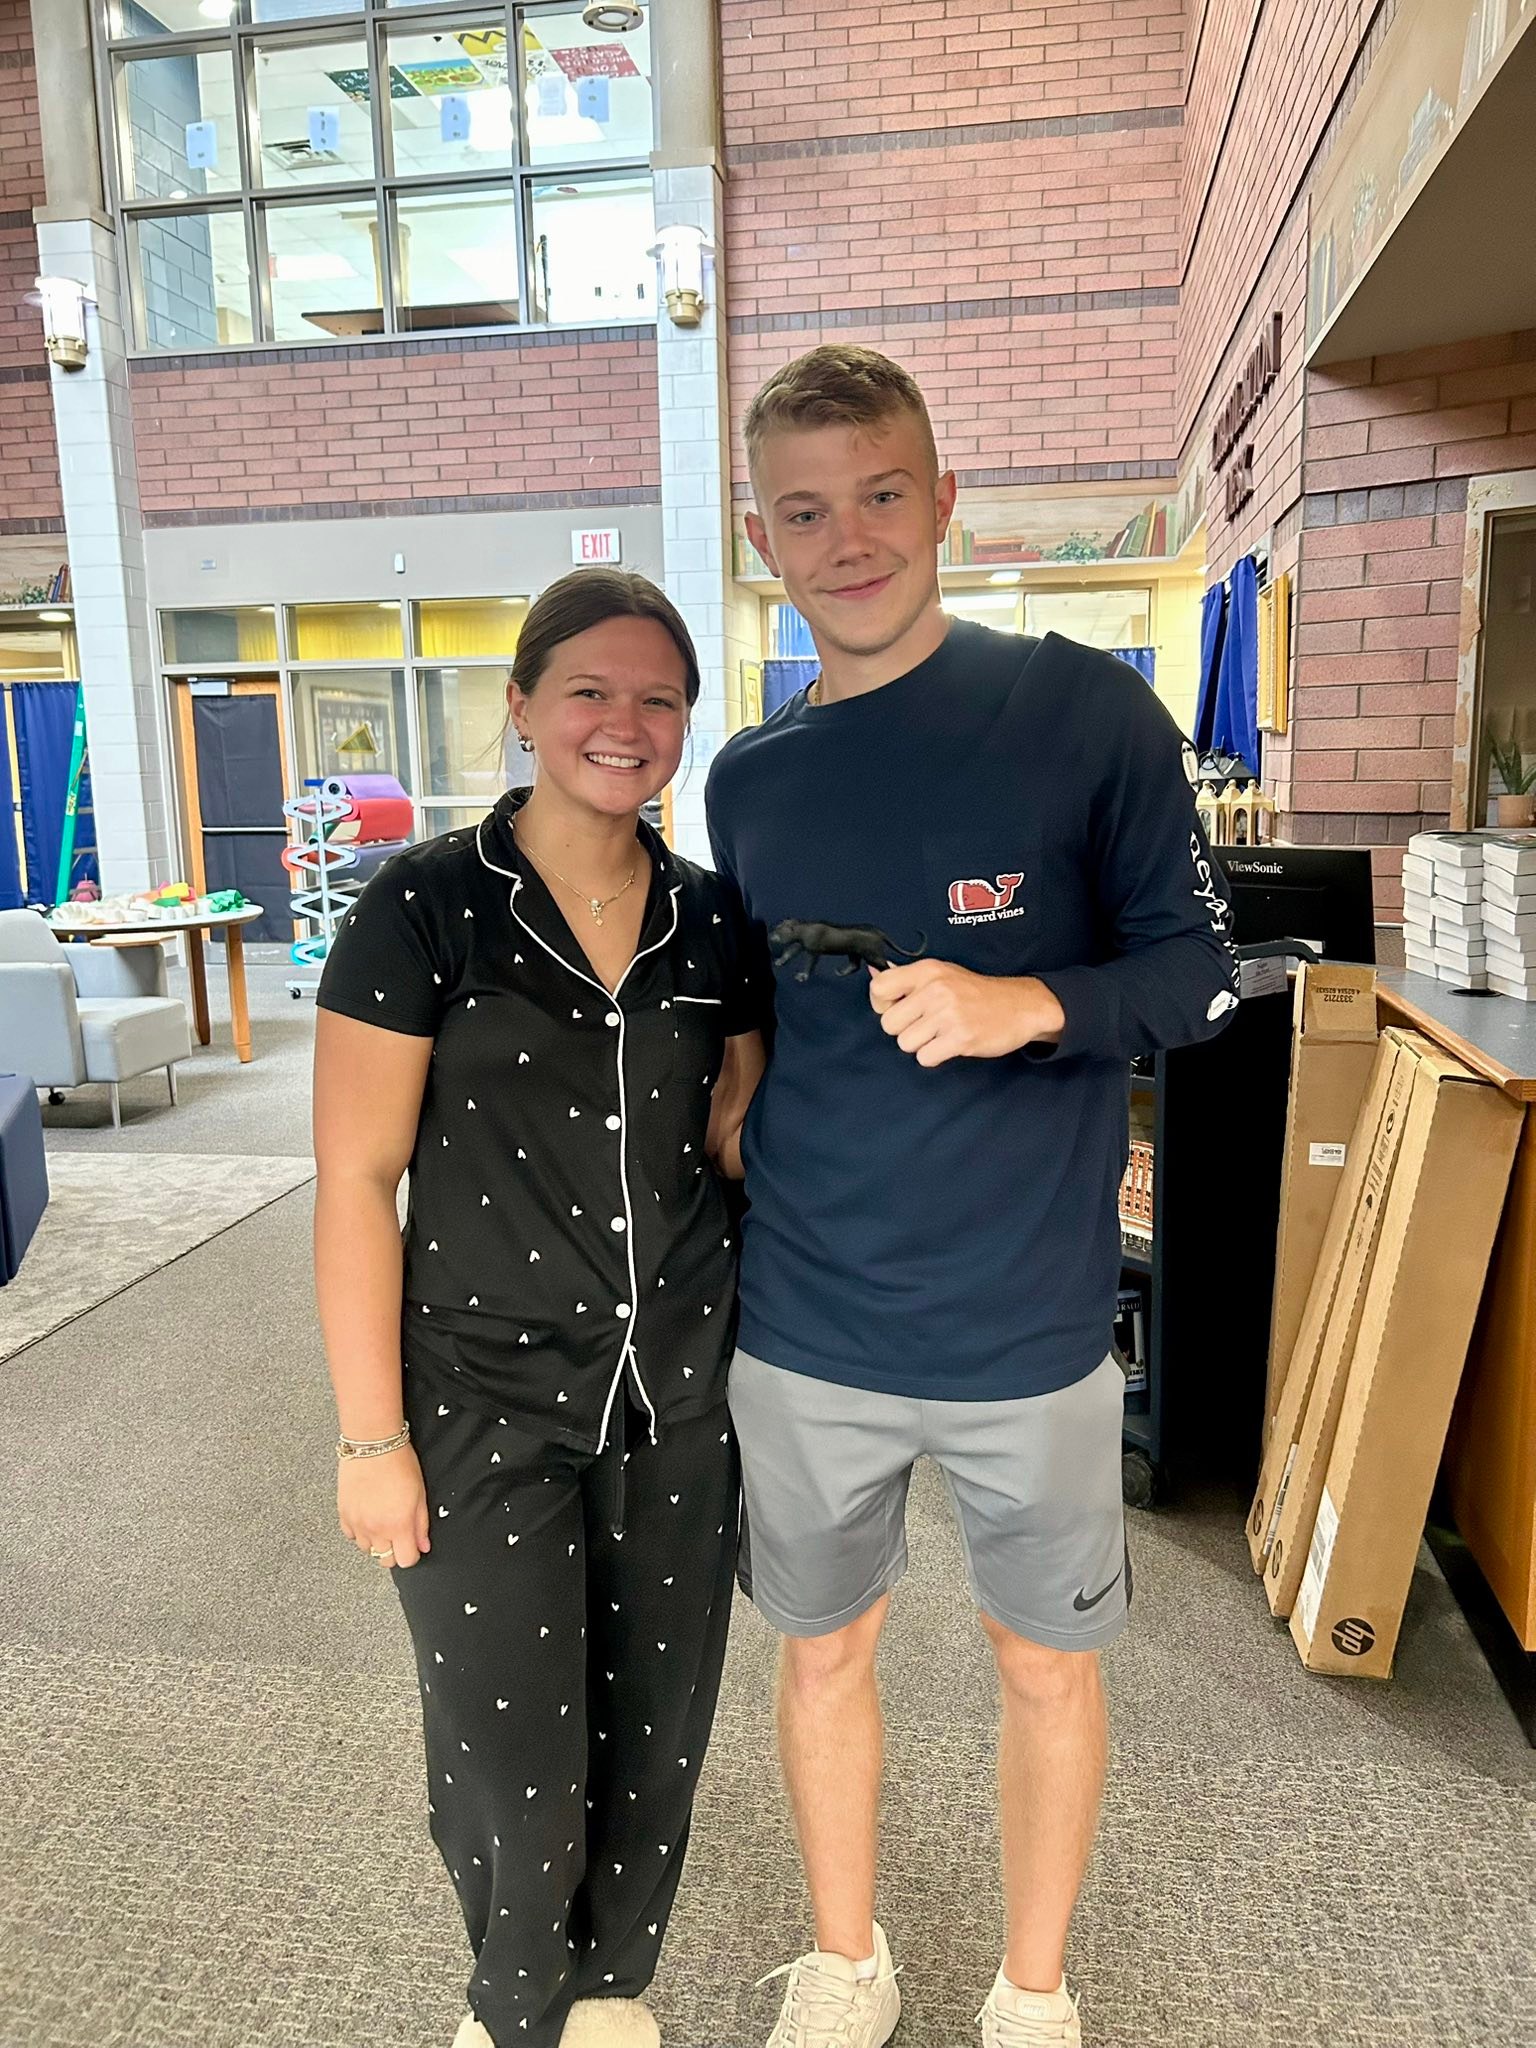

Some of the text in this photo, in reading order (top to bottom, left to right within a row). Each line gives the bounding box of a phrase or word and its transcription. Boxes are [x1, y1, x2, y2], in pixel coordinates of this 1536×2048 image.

[581, 533, 611, 559] EXIT
[1226, 860, 1284, 874] ViewSonic
[947, 906, 1025, 926] vineyard vines
[1323, 993, 1354, 1003] 3337212
